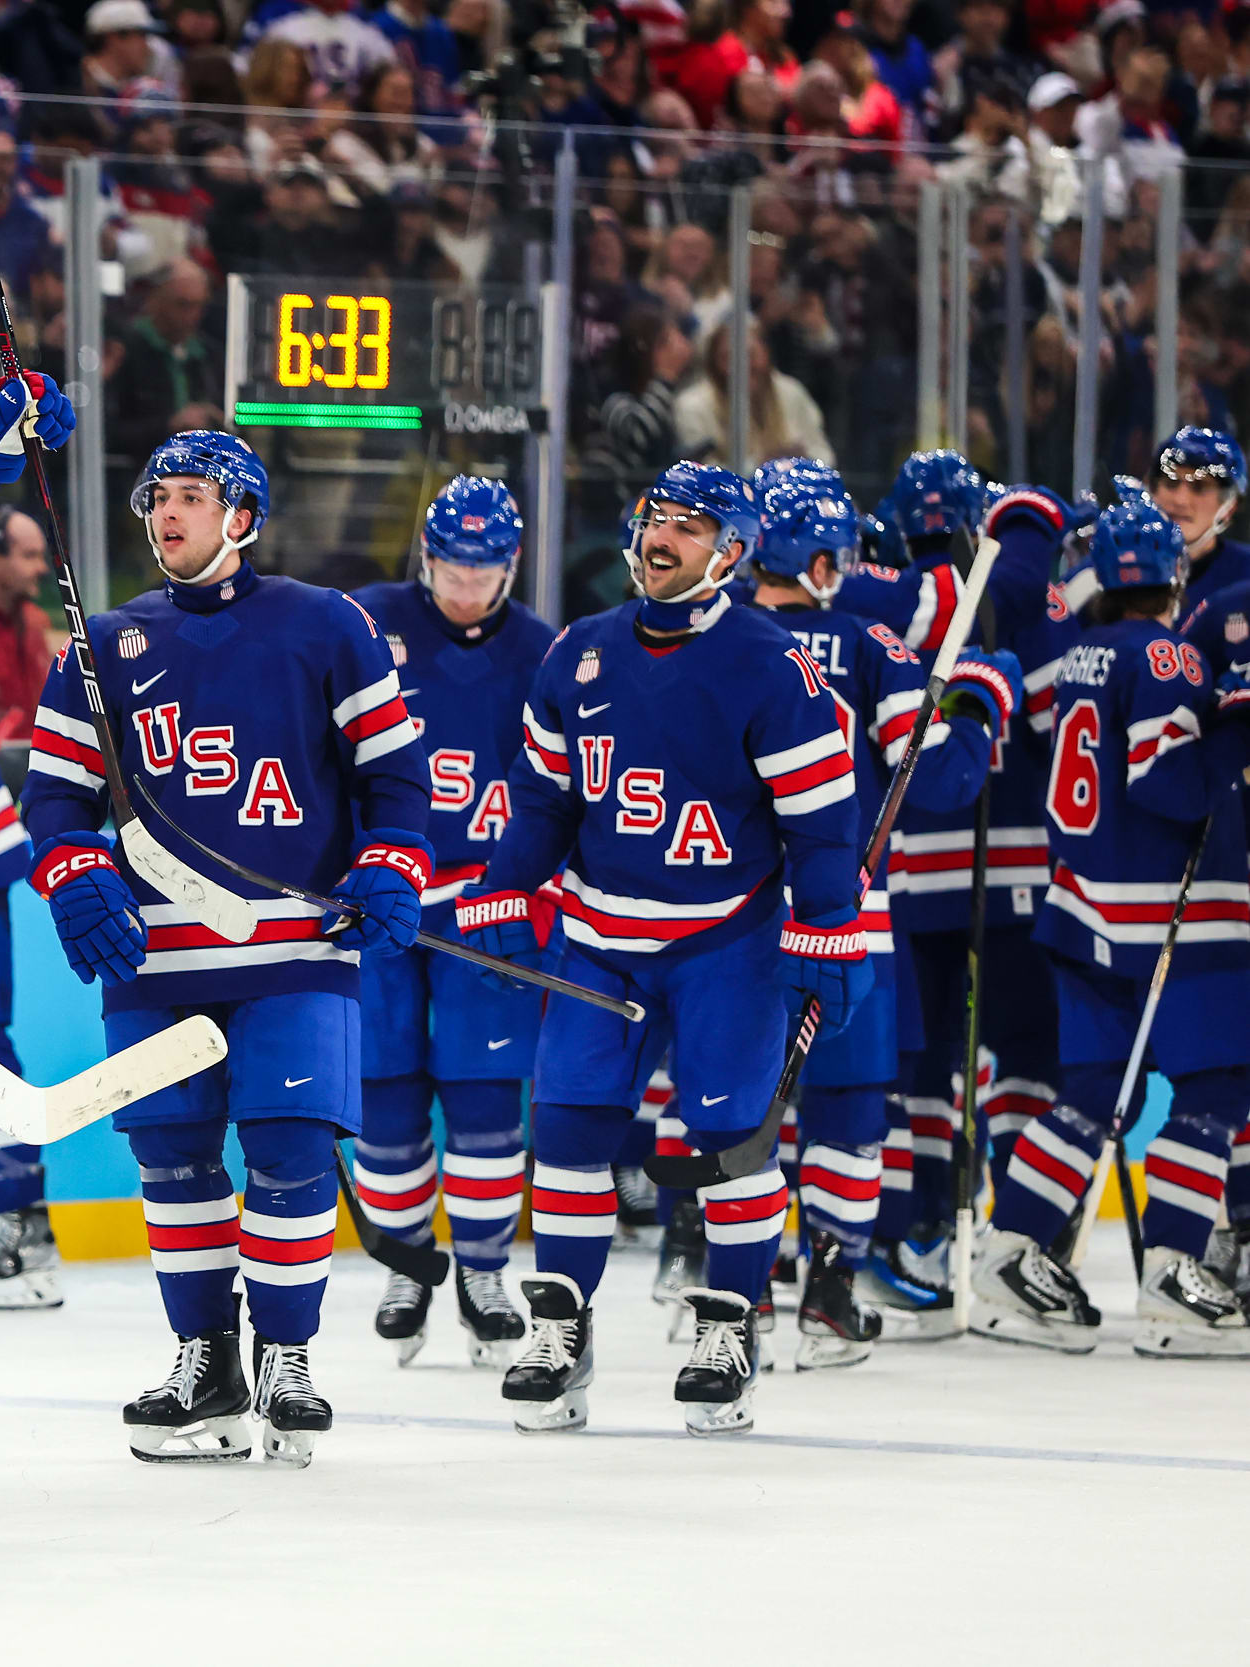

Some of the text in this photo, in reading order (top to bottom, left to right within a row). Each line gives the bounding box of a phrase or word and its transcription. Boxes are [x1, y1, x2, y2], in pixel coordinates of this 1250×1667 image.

[278, 293, 392, 390] 6:33
[237, 470, 261, 486] CCM
[58, 562, 106, 715] TRUE
[121, 628, 140, 638] USA
[867, 623, 921, 665] 5
[1145, 638, 1203, 687] 86
[131, 701, 304, 827] USA
[414, 717, 514, 842] SA
[577, 735, 733, 866] USA
[1046, 698, 1100, 836] 6
[358, 848, 428, 889] CCM
